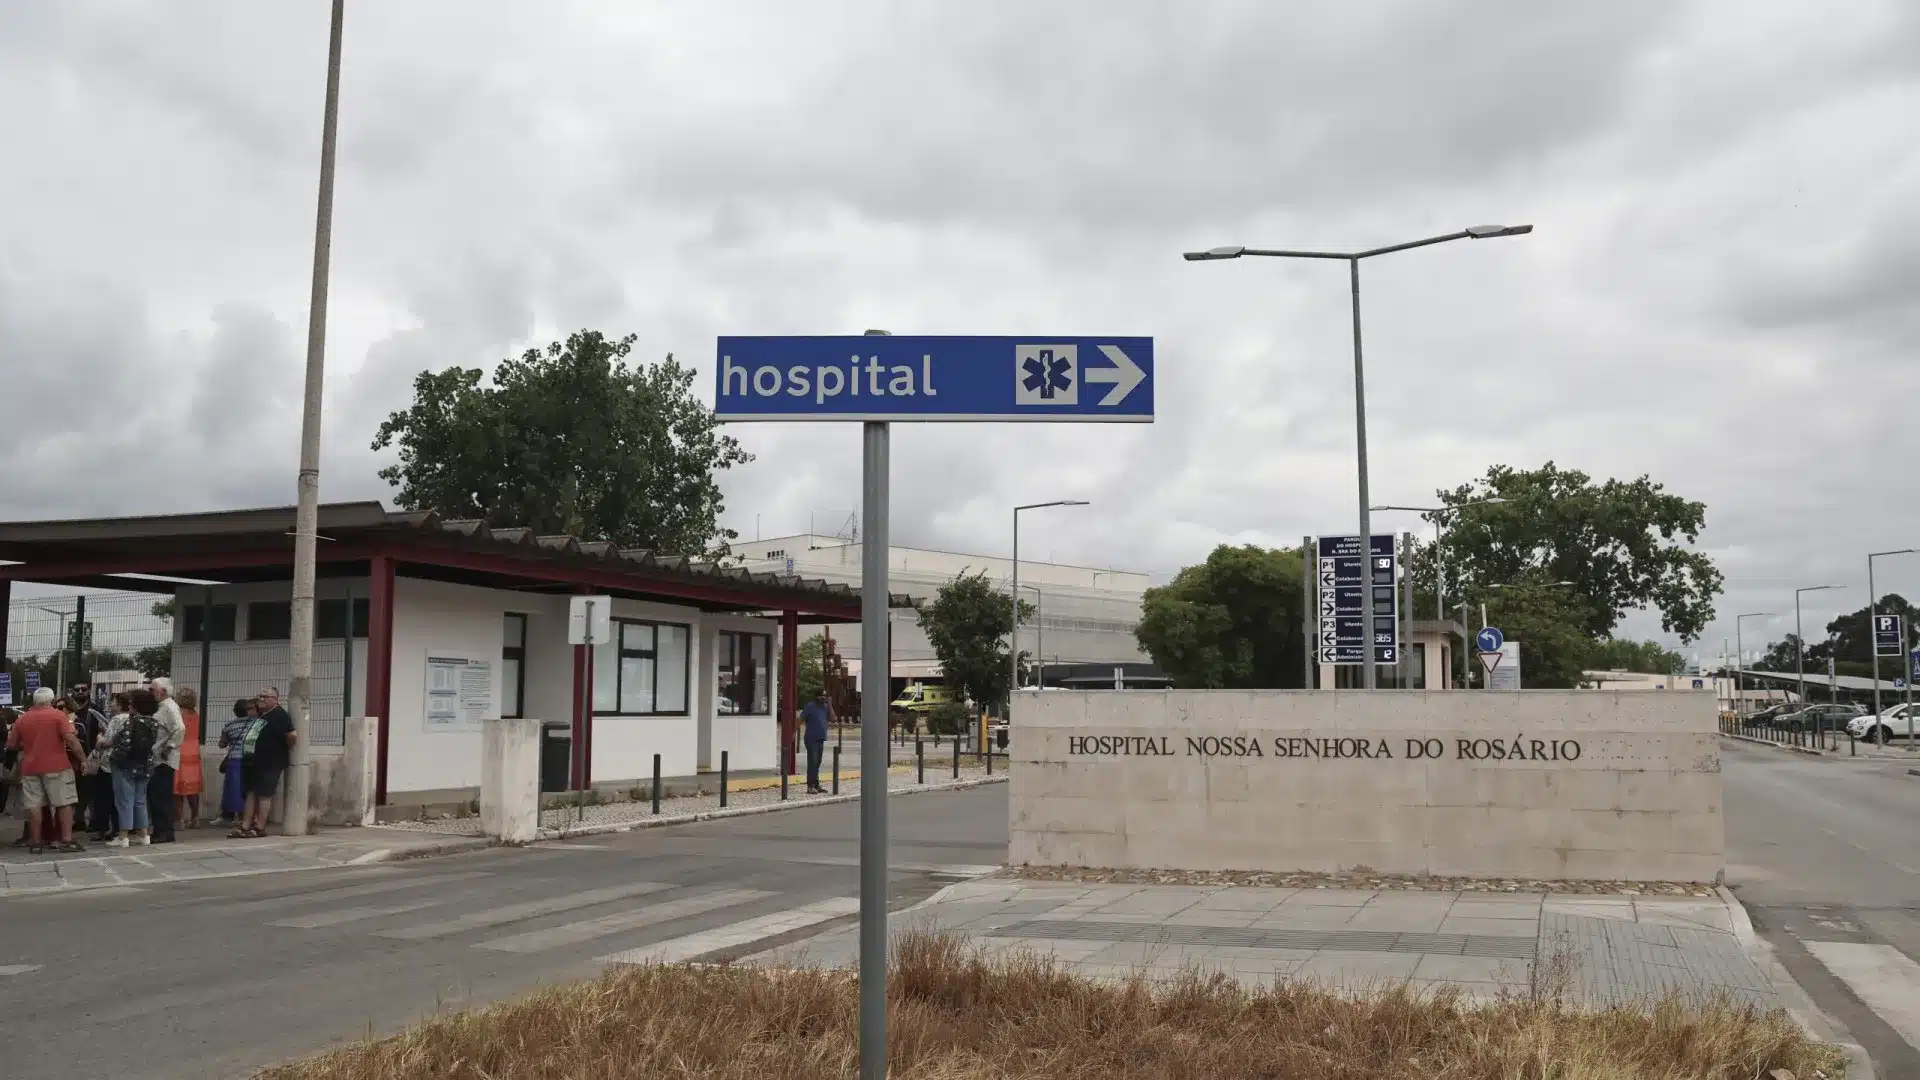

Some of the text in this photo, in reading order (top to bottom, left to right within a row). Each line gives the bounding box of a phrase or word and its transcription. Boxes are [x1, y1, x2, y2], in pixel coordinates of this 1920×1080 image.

[723, 354, 936, 404] hospital
[1379, 558, 1391, 569] 90
[1322, 591, 1335, 599] P2
[1384, 649, 1392, 659] 12
[1068, 733, 1581, 760] HOSPITAL NOSSA SENHORA DO ROSÁRIO
